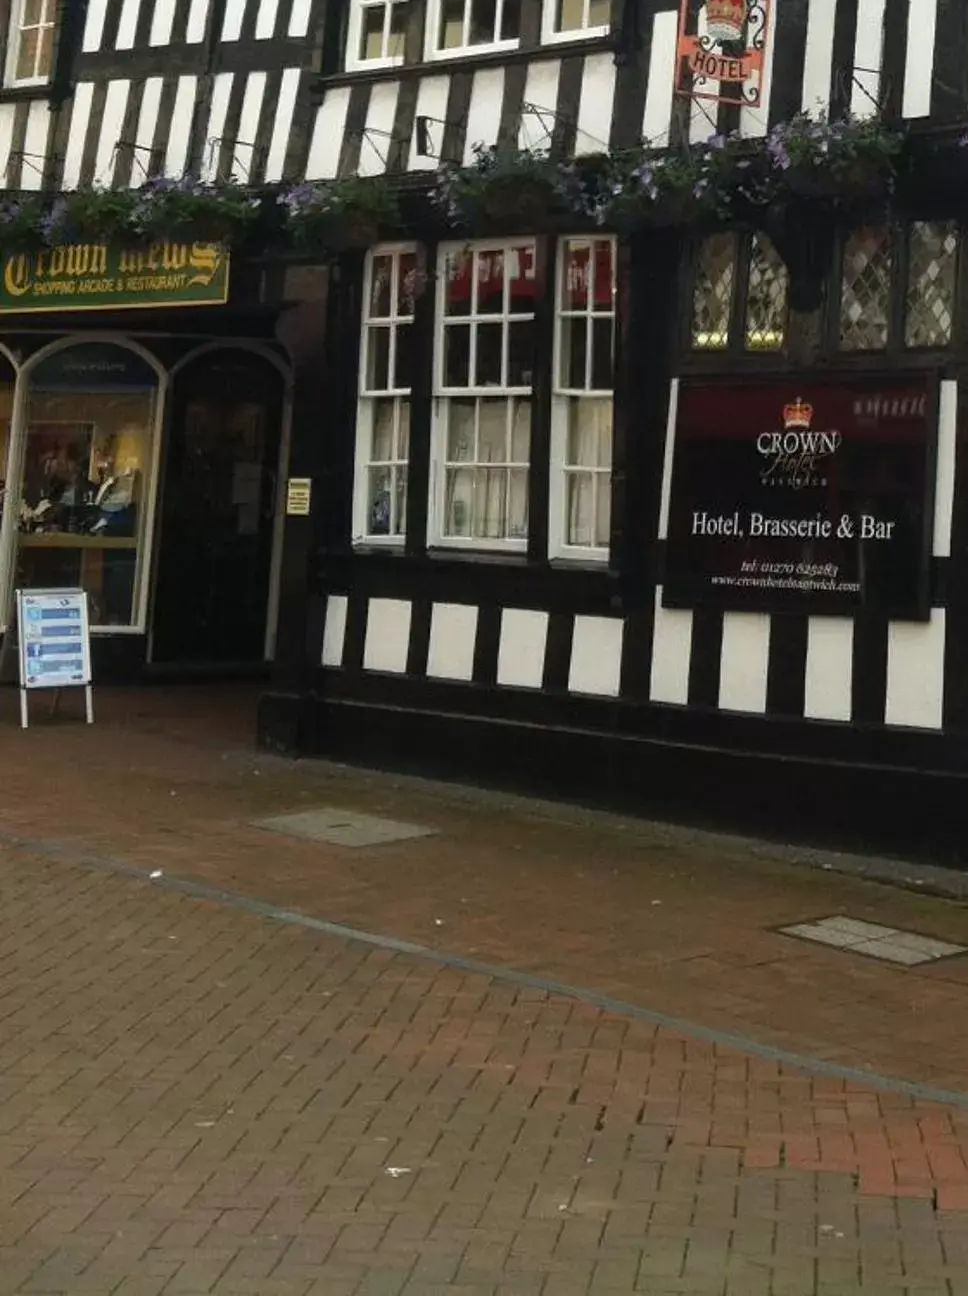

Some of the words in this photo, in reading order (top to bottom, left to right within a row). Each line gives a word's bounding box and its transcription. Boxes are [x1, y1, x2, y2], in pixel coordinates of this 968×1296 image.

[694, 51, 748, 78] HOTEL
[78, 278, 114, 293] ARCADE
[756, 431, 838, 455] CROWN
[691, 511, 744, 537] Hotel,
[749, 511, 832, 537] Brasserie
[836, 514, 854, 539] &
[859, 514, 896, 539] Bar
